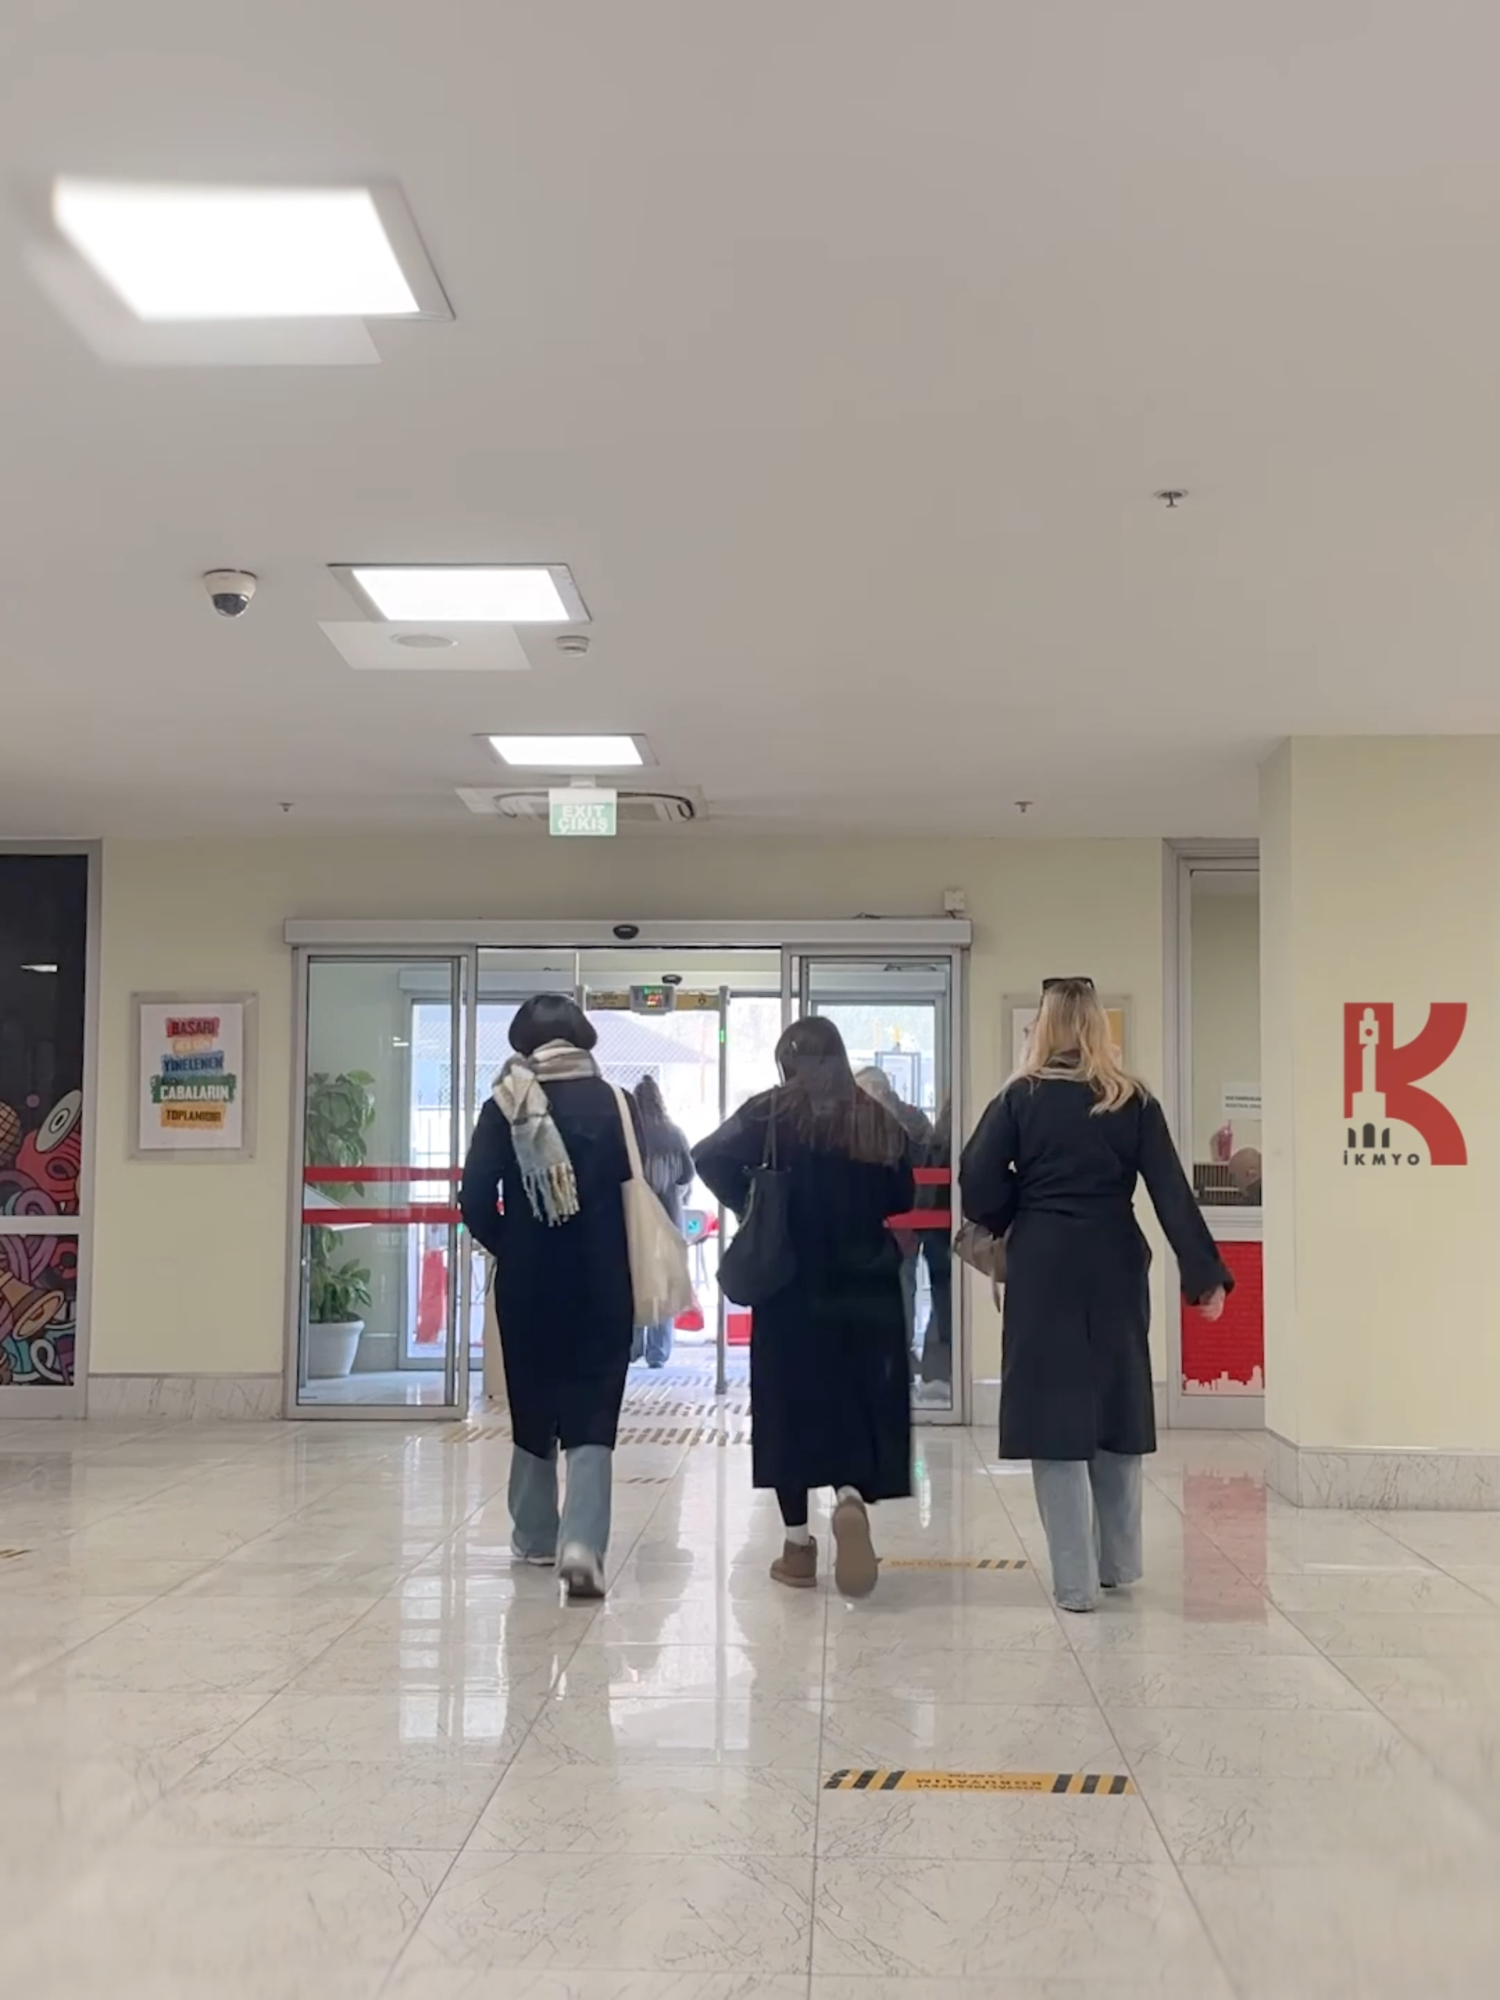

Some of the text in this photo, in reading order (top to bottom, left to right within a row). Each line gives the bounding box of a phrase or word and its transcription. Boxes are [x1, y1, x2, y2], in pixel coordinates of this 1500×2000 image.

[562, 804, 606, 818] EXIT
[558, 817, 609, 833] ÇIKIŞ
[1344, 1150, 1421, 1166] İKMYO
